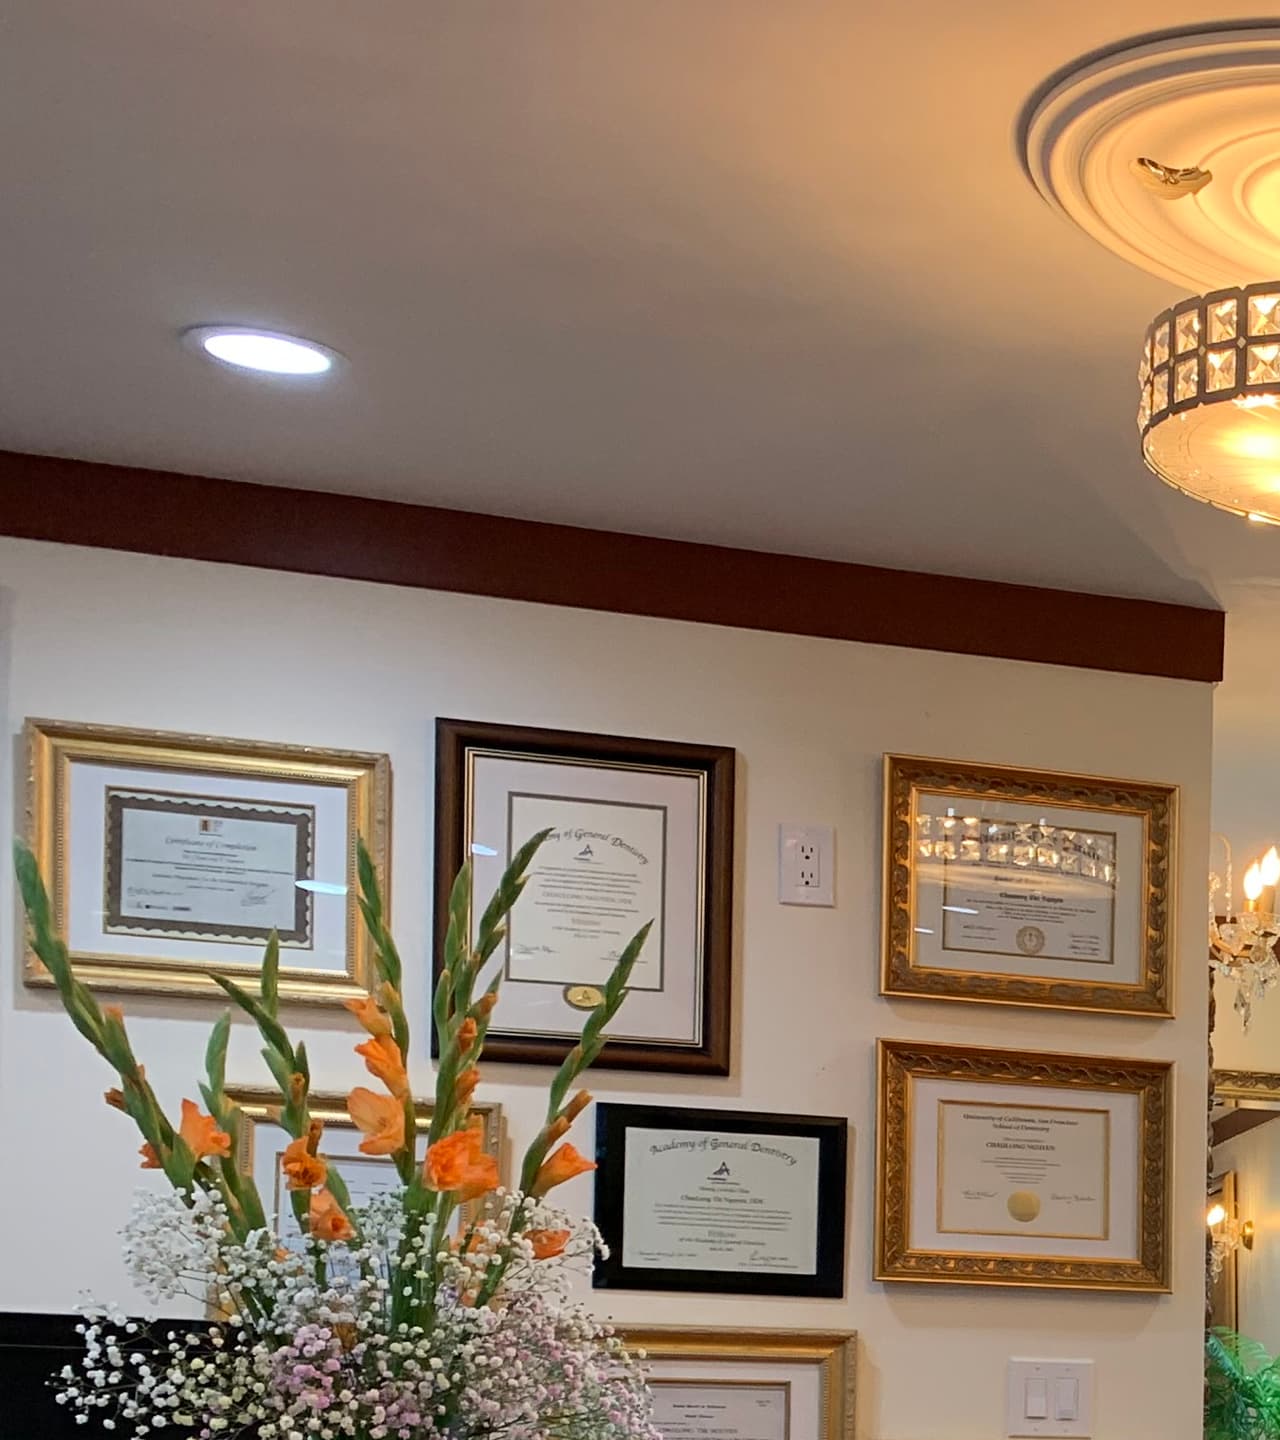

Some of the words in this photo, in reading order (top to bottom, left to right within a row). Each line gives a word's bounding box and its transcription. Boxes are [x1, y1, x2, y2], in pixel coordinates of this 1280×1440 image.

[650, 1138, 696, 1156] Academy
[710, 1138, 748, 1151] General
[751, 1142, 797, 1166] Dentistry
